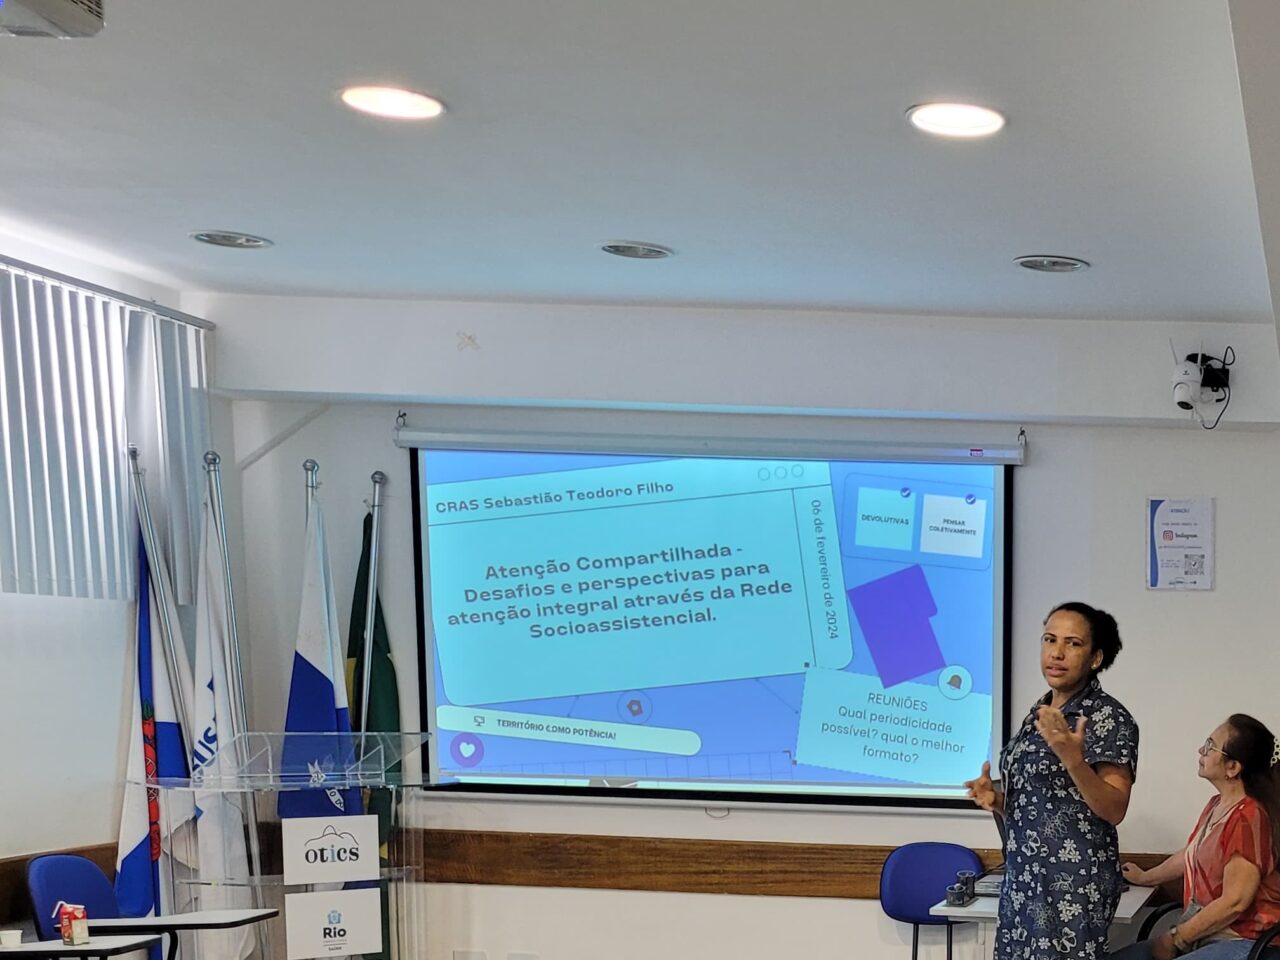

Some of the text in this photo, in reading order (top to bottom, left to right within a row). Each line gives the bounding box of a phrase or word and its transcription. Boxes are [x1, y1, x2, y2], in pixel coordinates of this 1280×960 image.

[436, 482, 674, 513] CRAS Sebastião Teodoro Filho
[861, 513, 909, 526] DEVOLUTIVAS
[928, 526, 977, 536] COLETIVAMENTE
[485, 560, 570, 580] Atenção
[576, 543, 731, 570] Compartilhada
[811, 499, 838, 640] 06 de fevereiro de 2024
[464, 562, 770, 603] Desafios e perspectivas para
[447, 579, 793, 626] atenção integral através da Rede
[529, 607, 717, 638] Socioassistencial.
[867, 692, 928, 712] REUNIÕES
[497, 719, 616, 741] TERRITÓRIO COMO POTÊNCIA!
[838, 706, 953, 733] Qual periodicidade
[820, 722, 965, 754] possível? qual o melhor
[862, 745, 919, 763] formato?
[305, 844, 359, 864] otics
[323, 926, 347, 939] Rio
